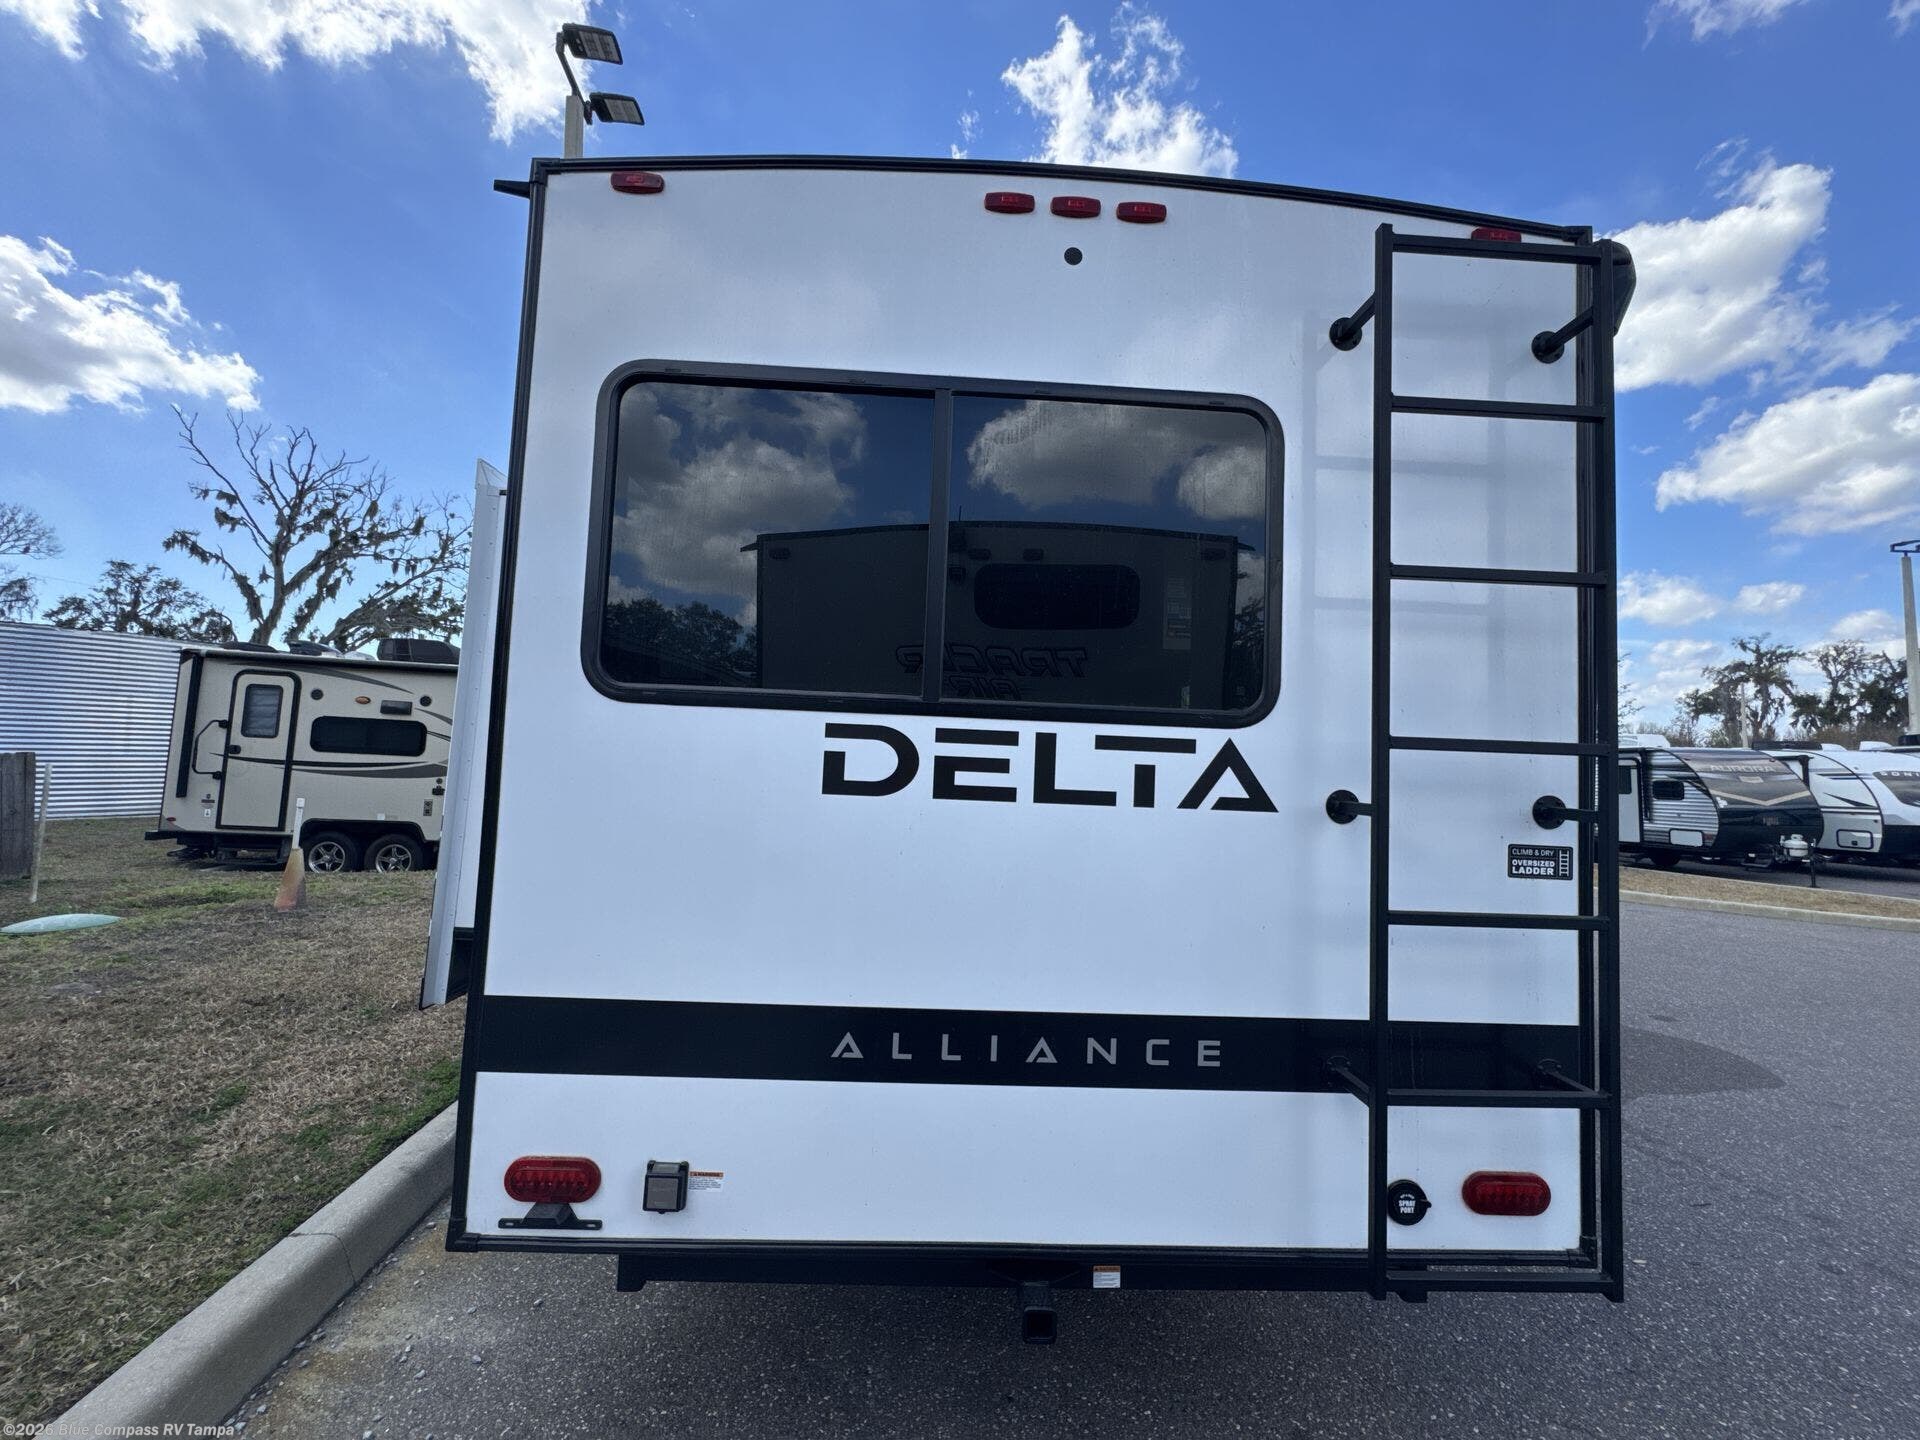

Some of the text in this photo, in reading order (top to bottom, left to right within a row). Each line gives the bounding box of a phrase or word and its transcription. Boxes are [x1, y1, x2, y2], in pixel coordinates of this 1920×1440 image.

[822, 723, 1279, 813] DELTA
[1512, 848, 1533, 856] CLIMB
[1540, 849, 1555, 857] DRY
[1512, 859, 1555, 867] OVERSIZED
[1512, 866, 1554, 876] LADDER
[831, 1032, 1221, 1067] ALLIANCE
